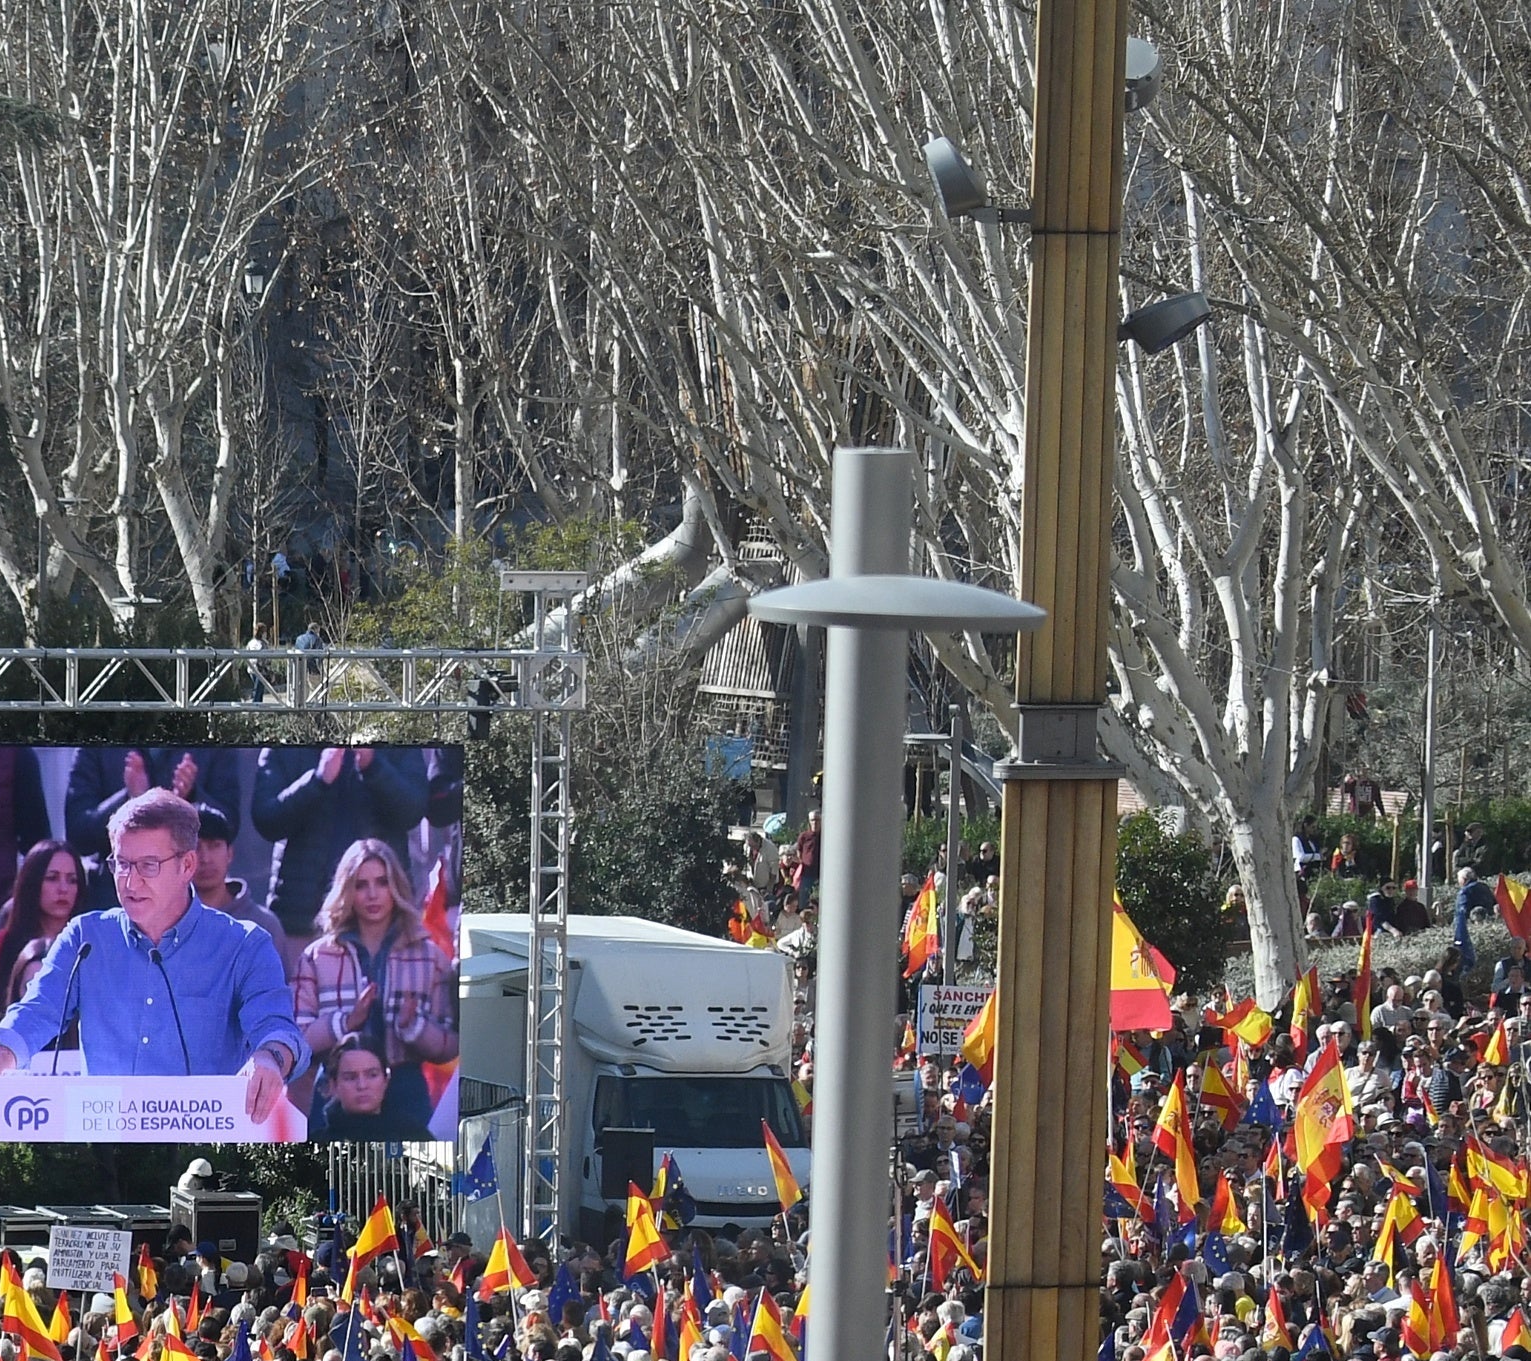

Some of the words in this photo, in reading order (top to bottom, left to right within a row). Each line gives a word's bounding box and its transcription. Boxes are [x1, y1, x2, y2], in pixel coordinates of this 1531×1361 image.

[82, 1101, 113, 1113] POR
[119, 1101, 137, 1113] LA
[142, 1100, 222, 1113] IGUALDAD
[82, 1118, 103, 1130] DE
[107, 1118, 137, 1130] LOS
[141, 1113, 234, 1130] ESPAÑOLES
